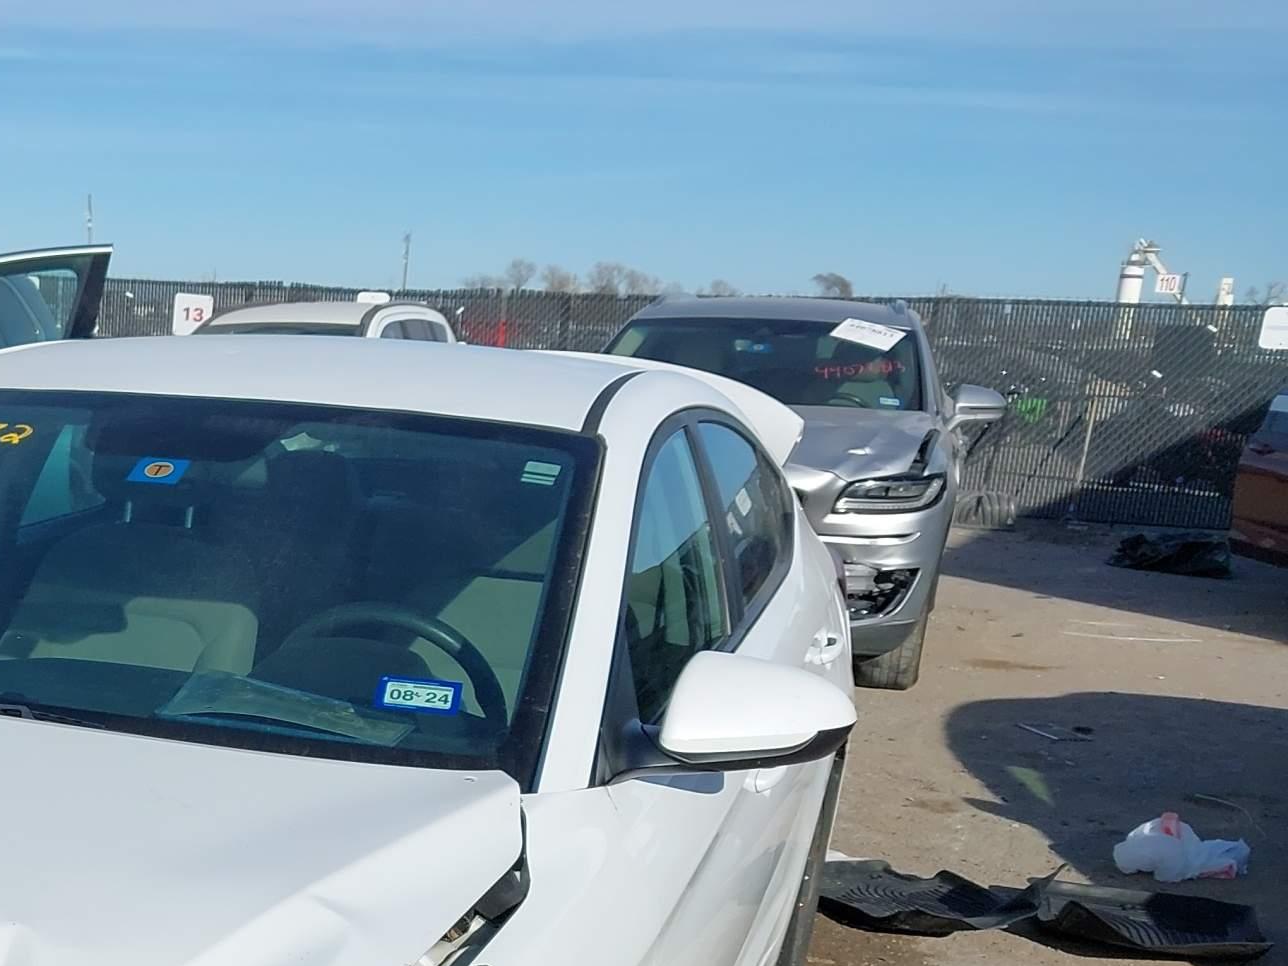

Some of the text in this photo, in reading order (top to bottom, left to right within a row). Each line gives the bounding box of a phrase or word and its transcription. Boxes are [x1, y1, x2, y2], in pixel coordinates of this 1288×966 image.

[1159, 276, 1177, 291] 110
[182, 306, 204, 322] 13
[423, 692, 450, 705] 24
